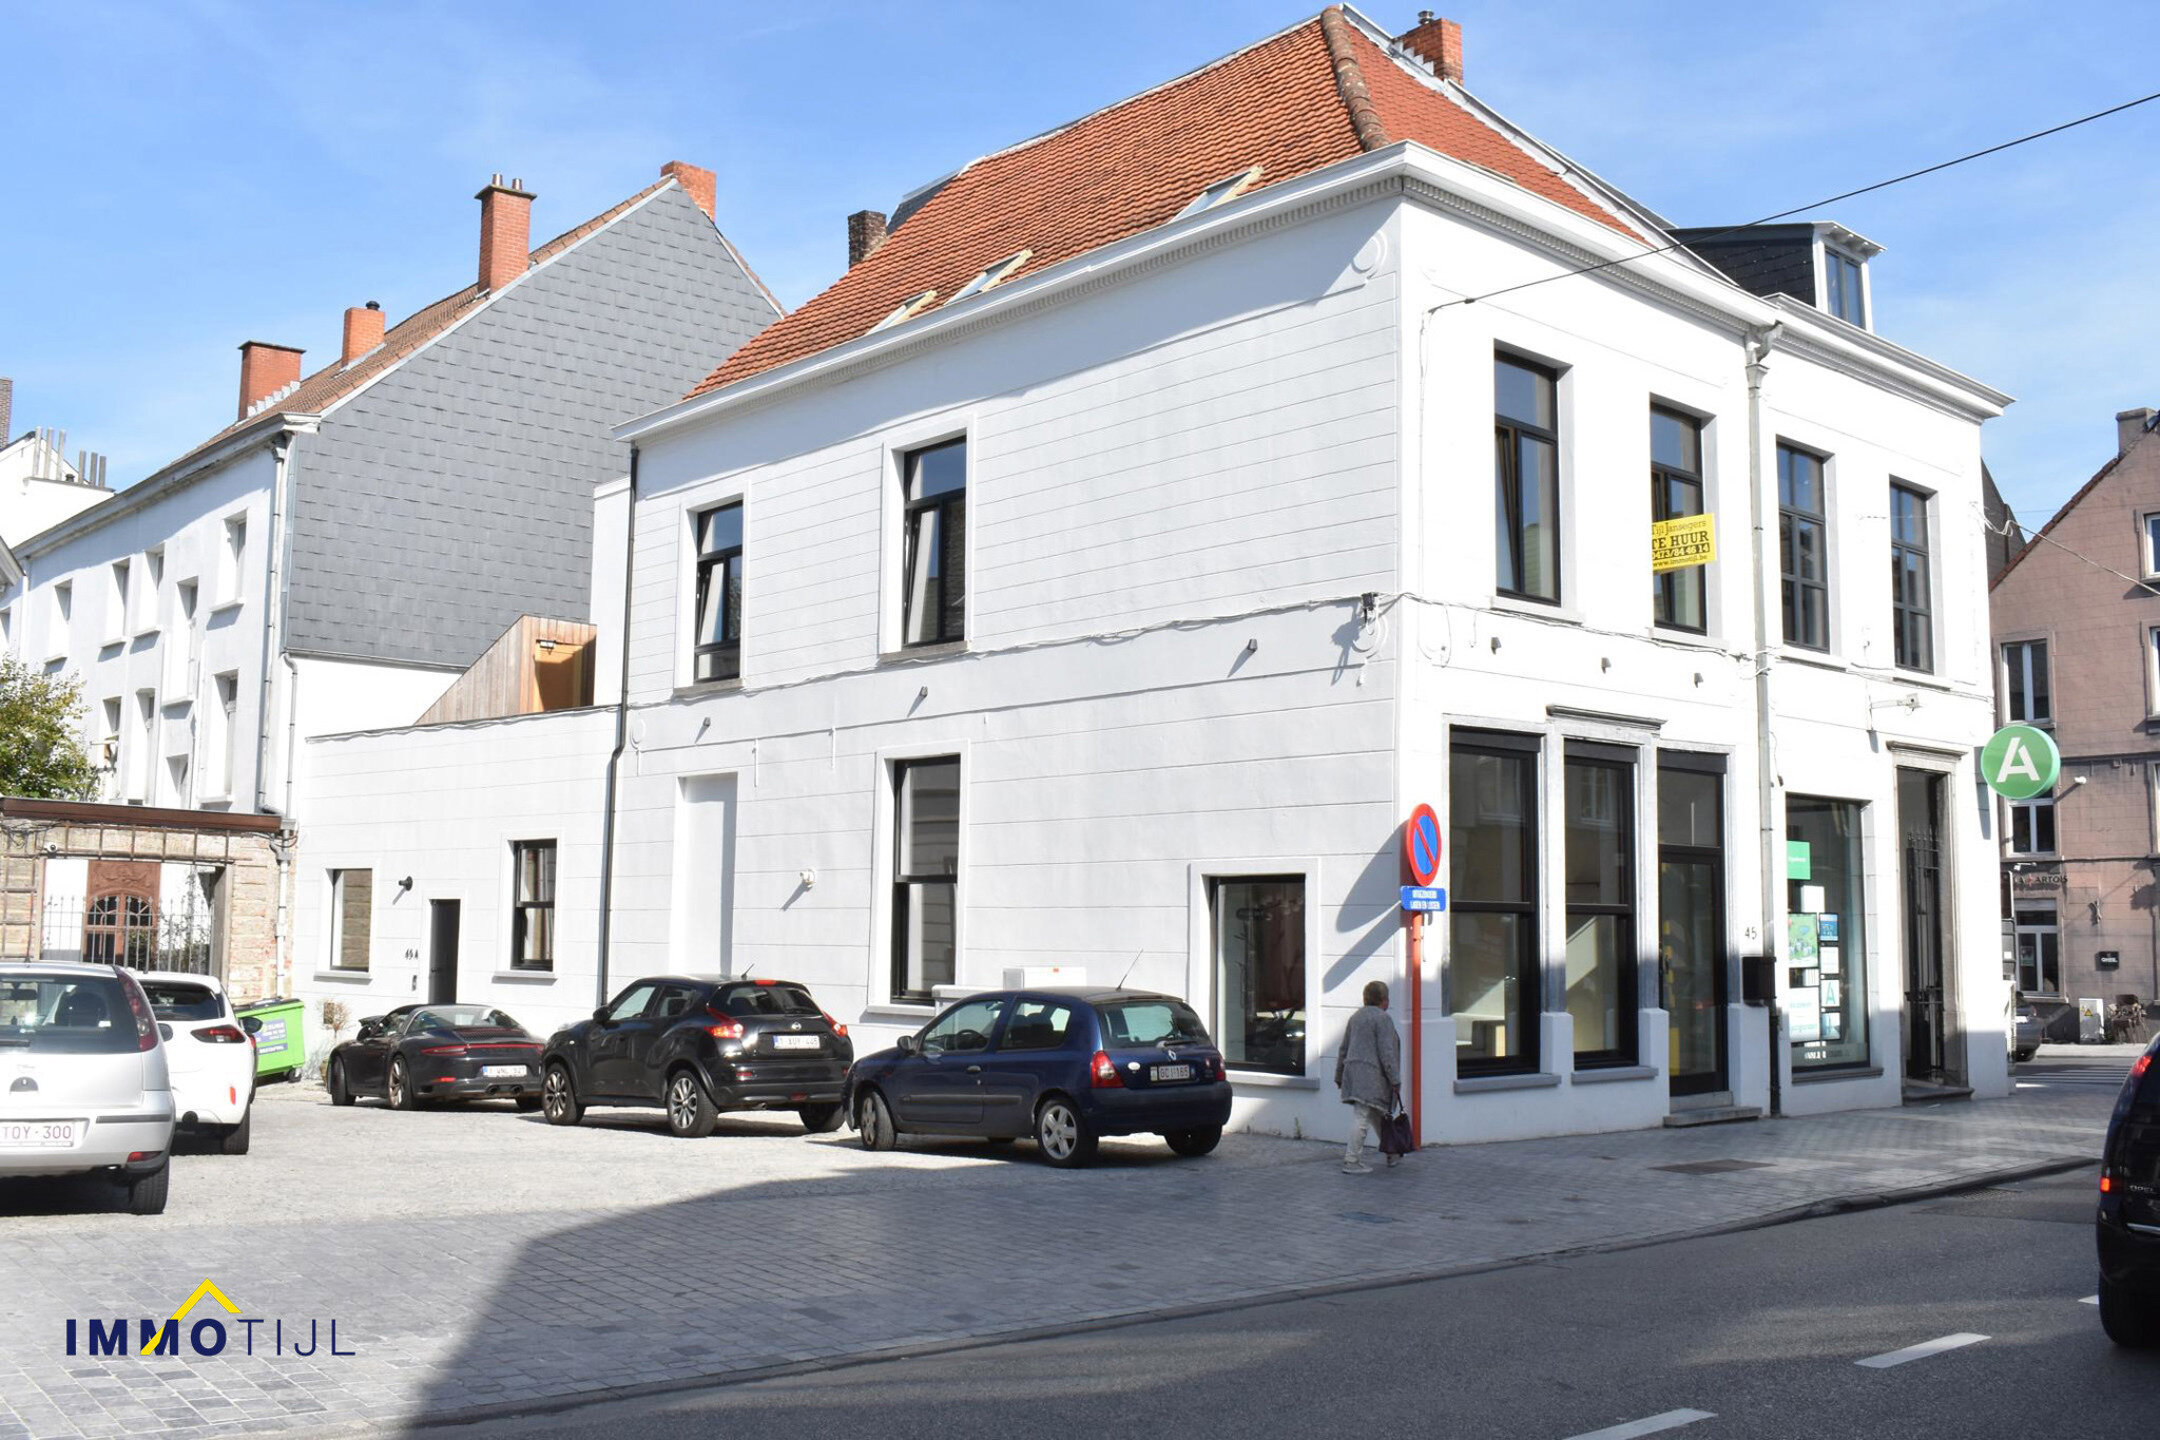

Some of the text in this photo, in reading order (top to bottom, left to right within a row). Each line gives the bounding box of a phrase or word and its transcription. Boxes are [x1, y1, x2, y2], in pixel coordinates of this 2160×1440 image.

[1670, 530, 1710, 547] HUUR
[1996, 736, 2041, 783] A
[1745, 926, 1758, 940] 45
